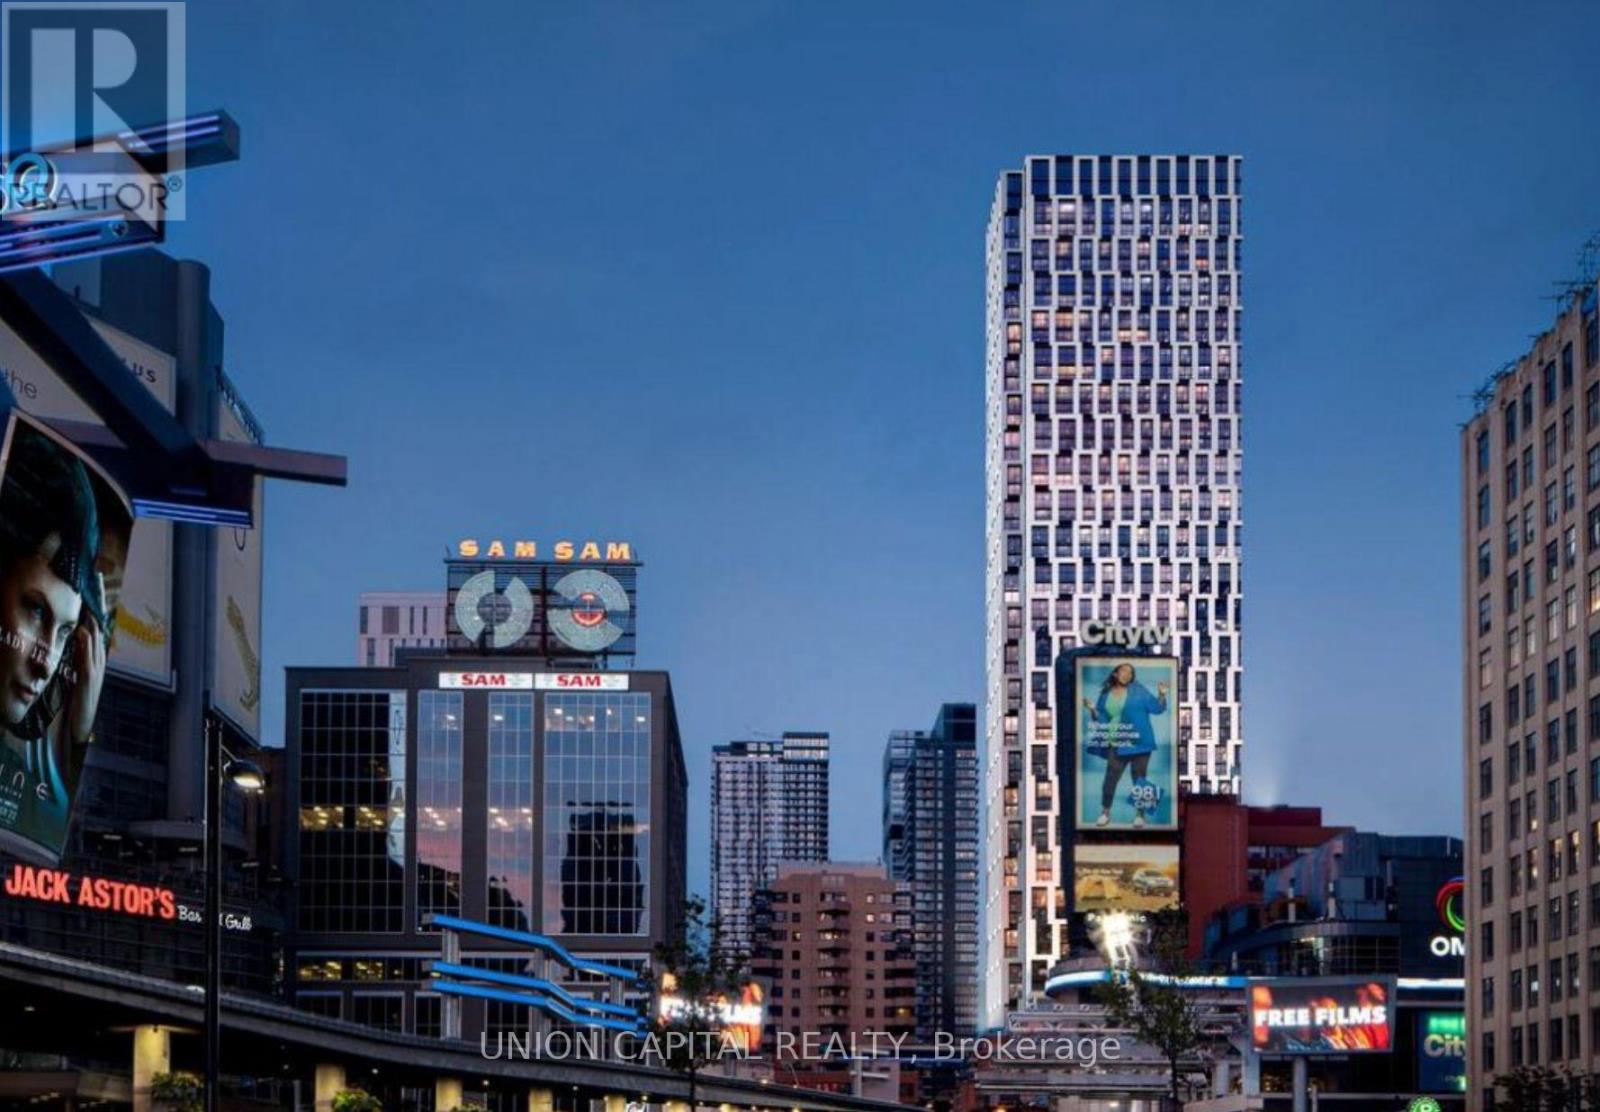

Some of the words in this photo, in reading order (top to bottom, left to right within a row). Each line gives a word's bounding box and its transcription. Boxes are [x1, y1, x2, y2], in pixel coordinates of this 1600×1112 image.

[459, 540, 537, 558] SAM
[554, 541, 631, 560] SAM
[1080, 619, 1170, 648] Citytv
[461, 673, 506, 686] SAM
[557, 674, 601, 687] SAM
[6, 864, 70, 903] JACK
[78, 877, 175, 920] ASTOR'S
[1253, 1008, 1310, 1027] FREE
[1315, 1006, 1386, 1026] FILMS
[1424, 1034, 1466, 1060] Cit
